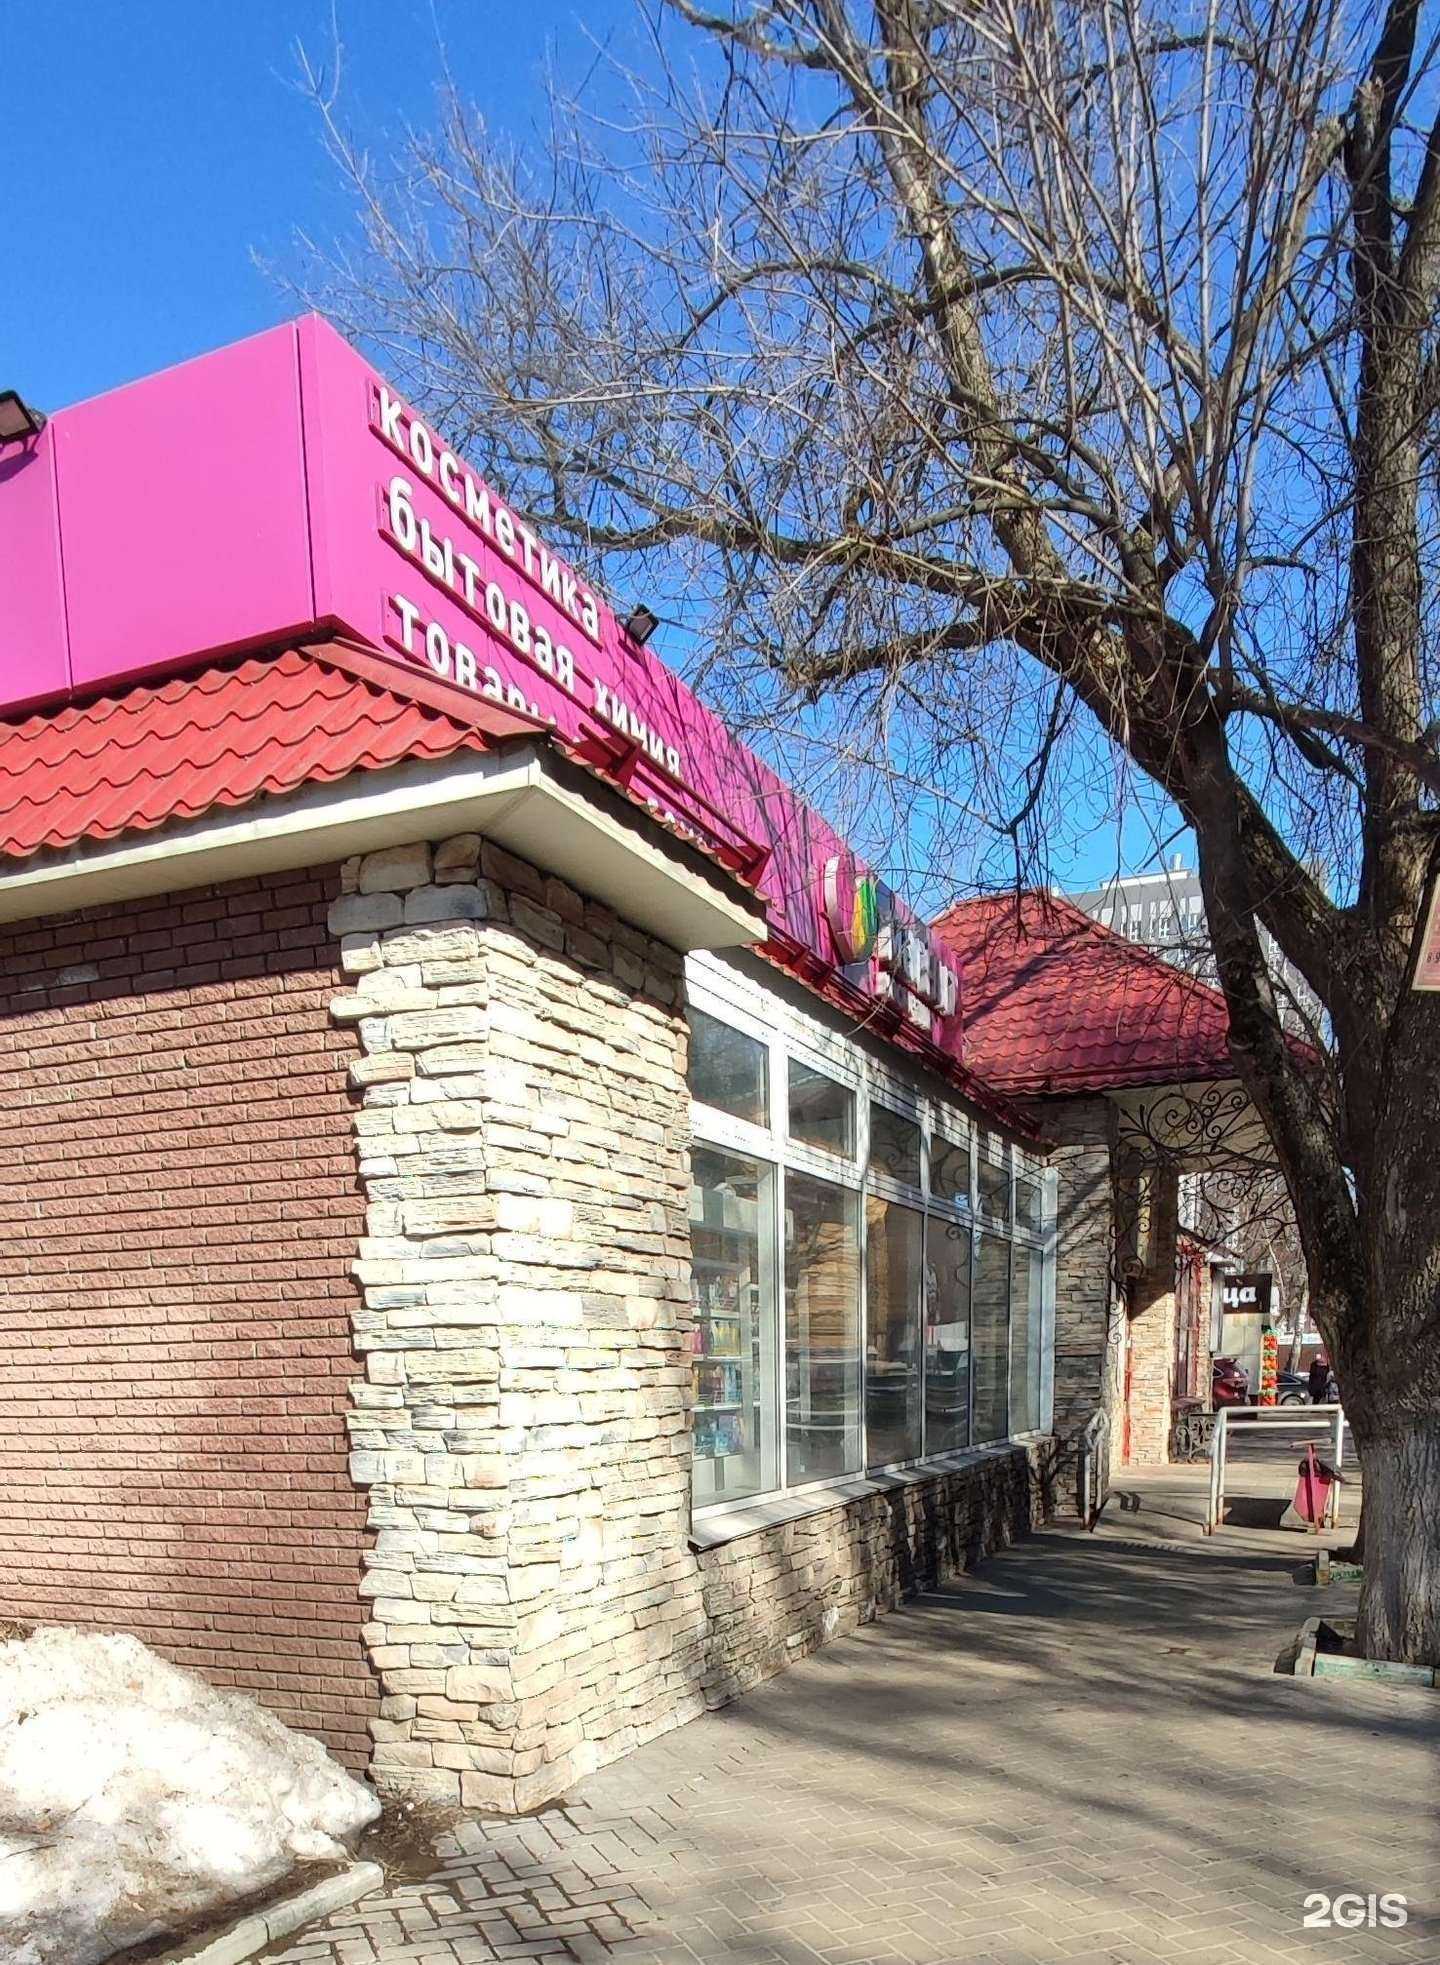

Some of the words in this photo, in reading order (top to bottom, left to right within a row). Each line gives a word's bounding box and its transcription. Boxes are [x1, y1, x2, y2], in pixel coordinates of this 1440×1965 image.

[380, 386, 600, 642] косметика
[390, 476, 574, 694] бытовая
[593, 677, 681, 778] химия
[395, 593, 557, 725] товар
